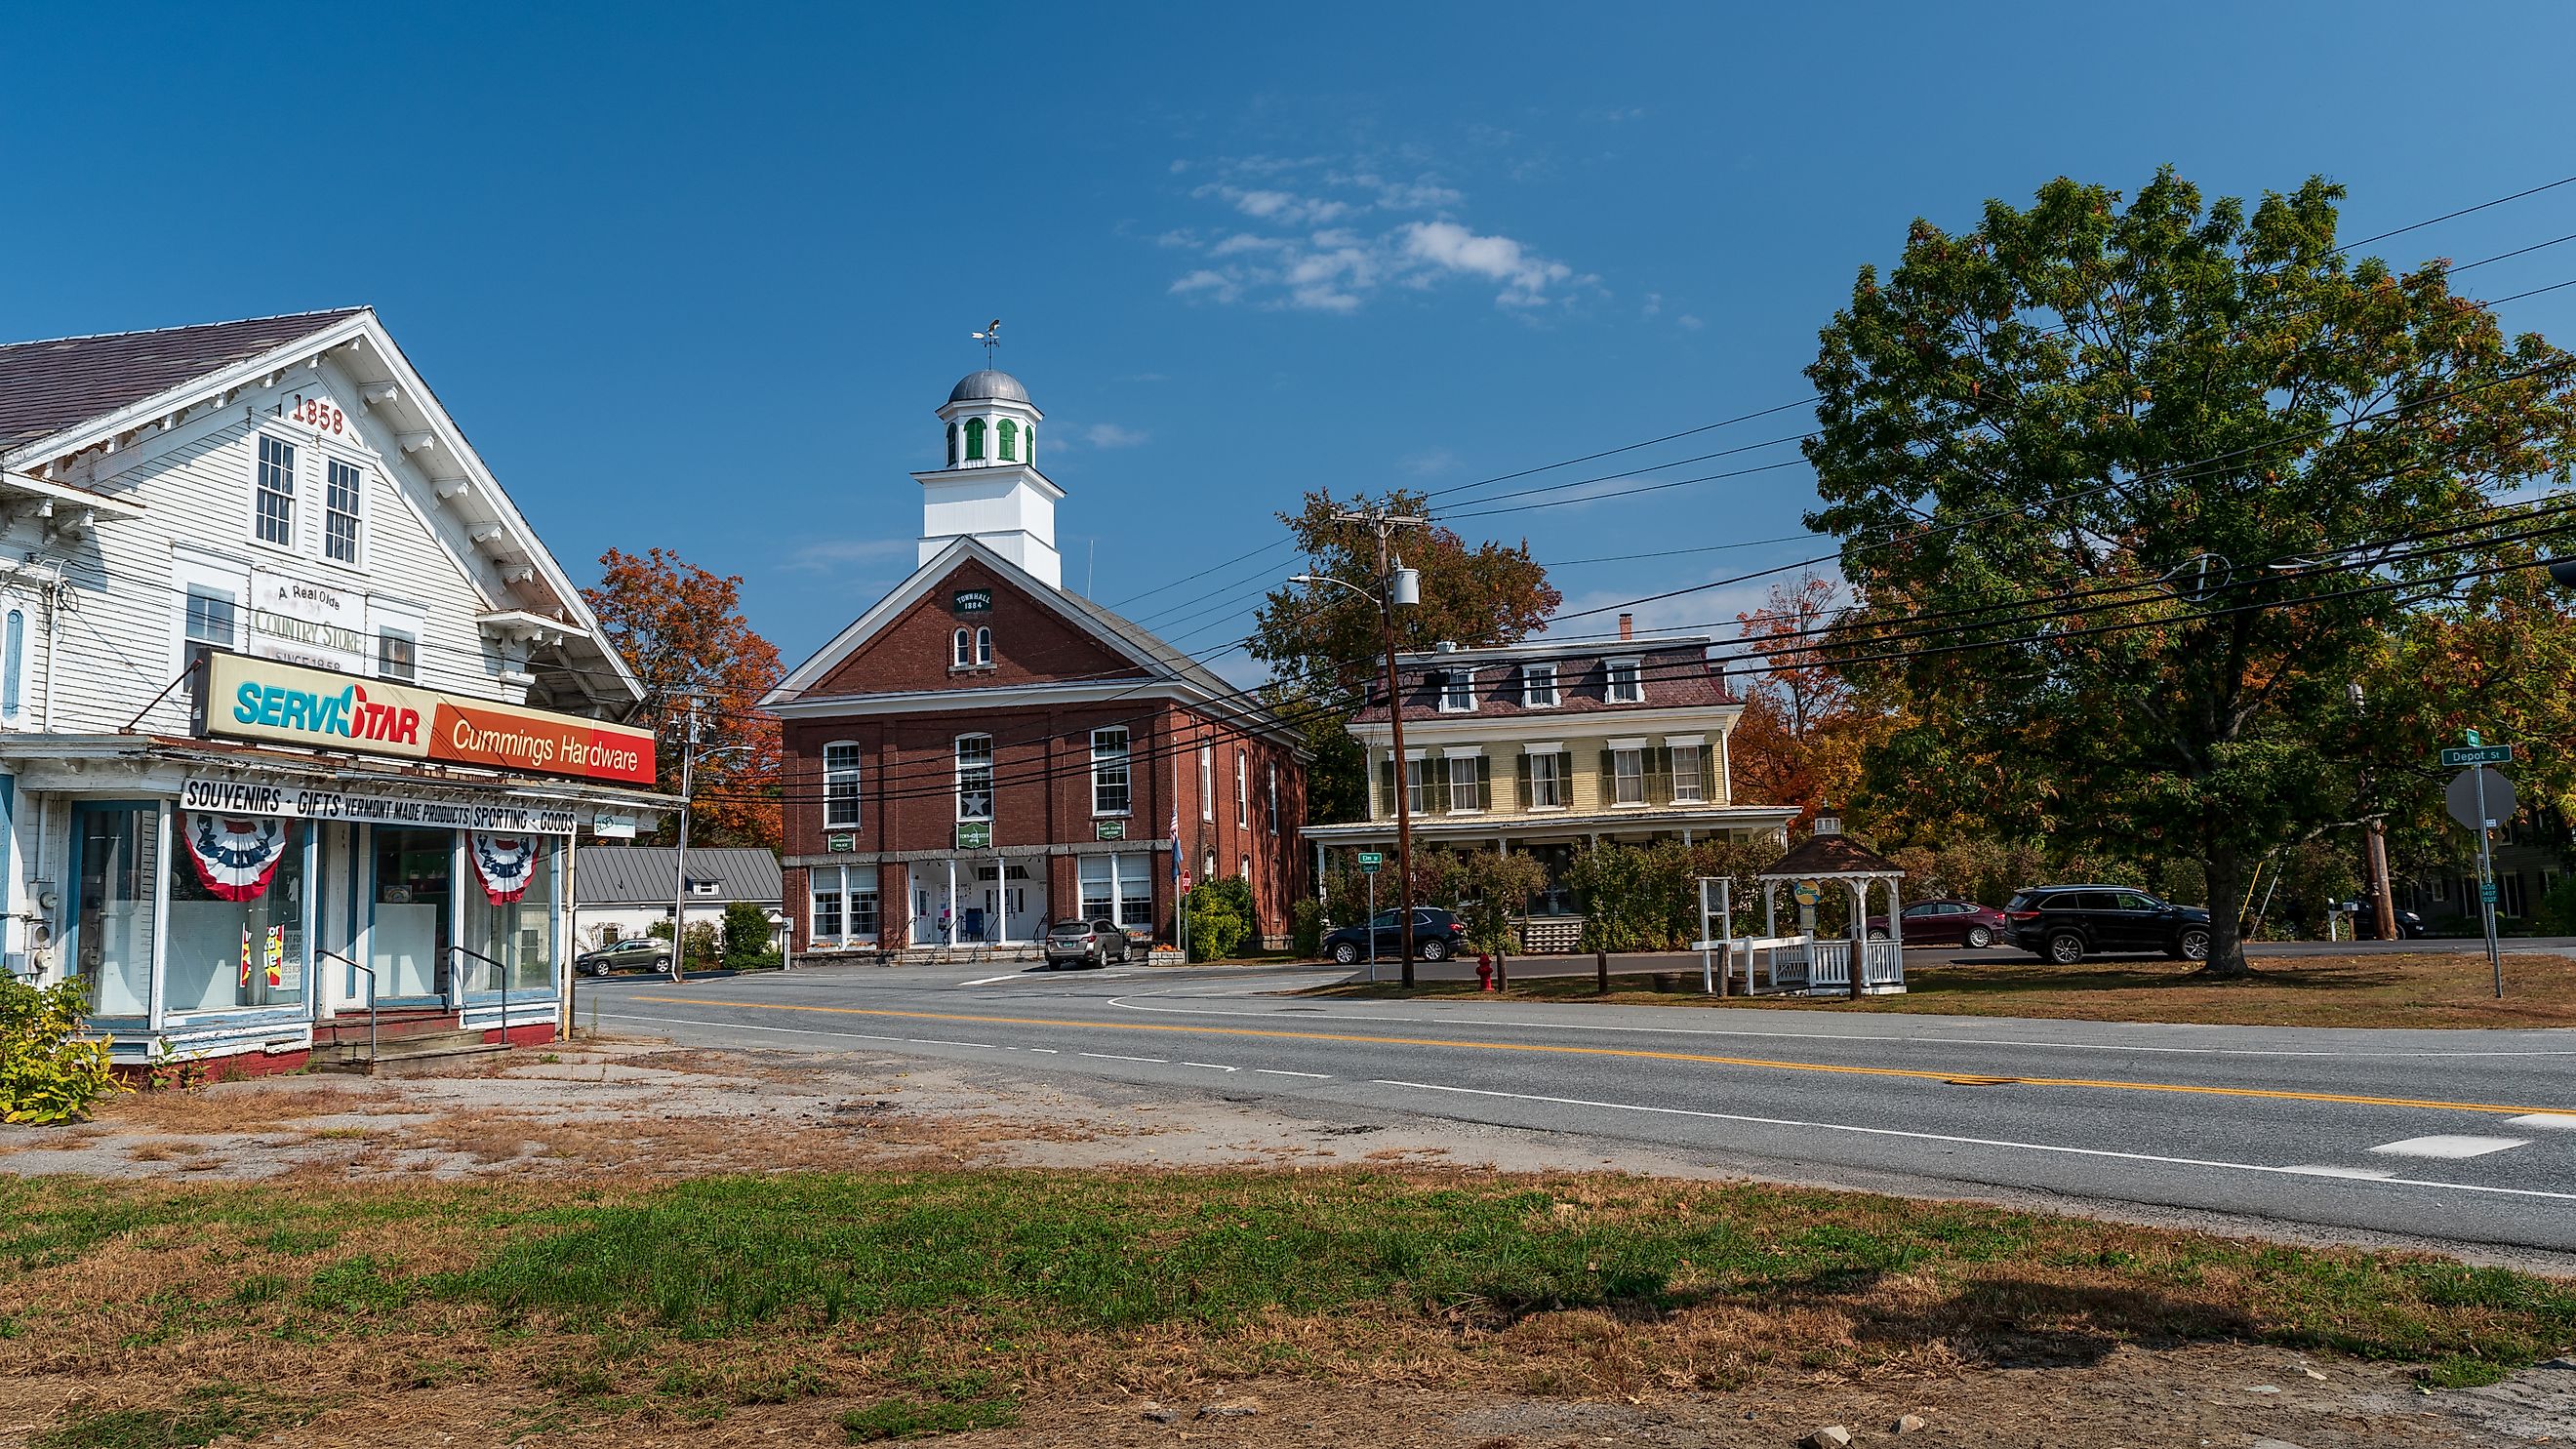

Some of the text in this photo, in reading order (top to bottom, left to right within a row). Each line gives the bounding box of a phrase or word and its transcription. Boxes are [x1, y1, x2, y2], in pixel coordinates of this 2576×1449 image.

[293, 394, 342, 434] 1858
[278, 586, 288, 600] A
[293, 585, 317, 600] Real
[956, 593, 990, 604] TOWN HALL
[233, 681, 420, 745] SERVISTAR
[453, 719, 638, 771] Cummings Hardware
[2453, 751, 2485, 762] Depot
[187, 782, 342, 818] SOUVENIRS GIFTS
[344, 798, 470, 825] VERMONT MADE PRODUCTS
[473, 807, 575, 832] SPORTING GOODS
